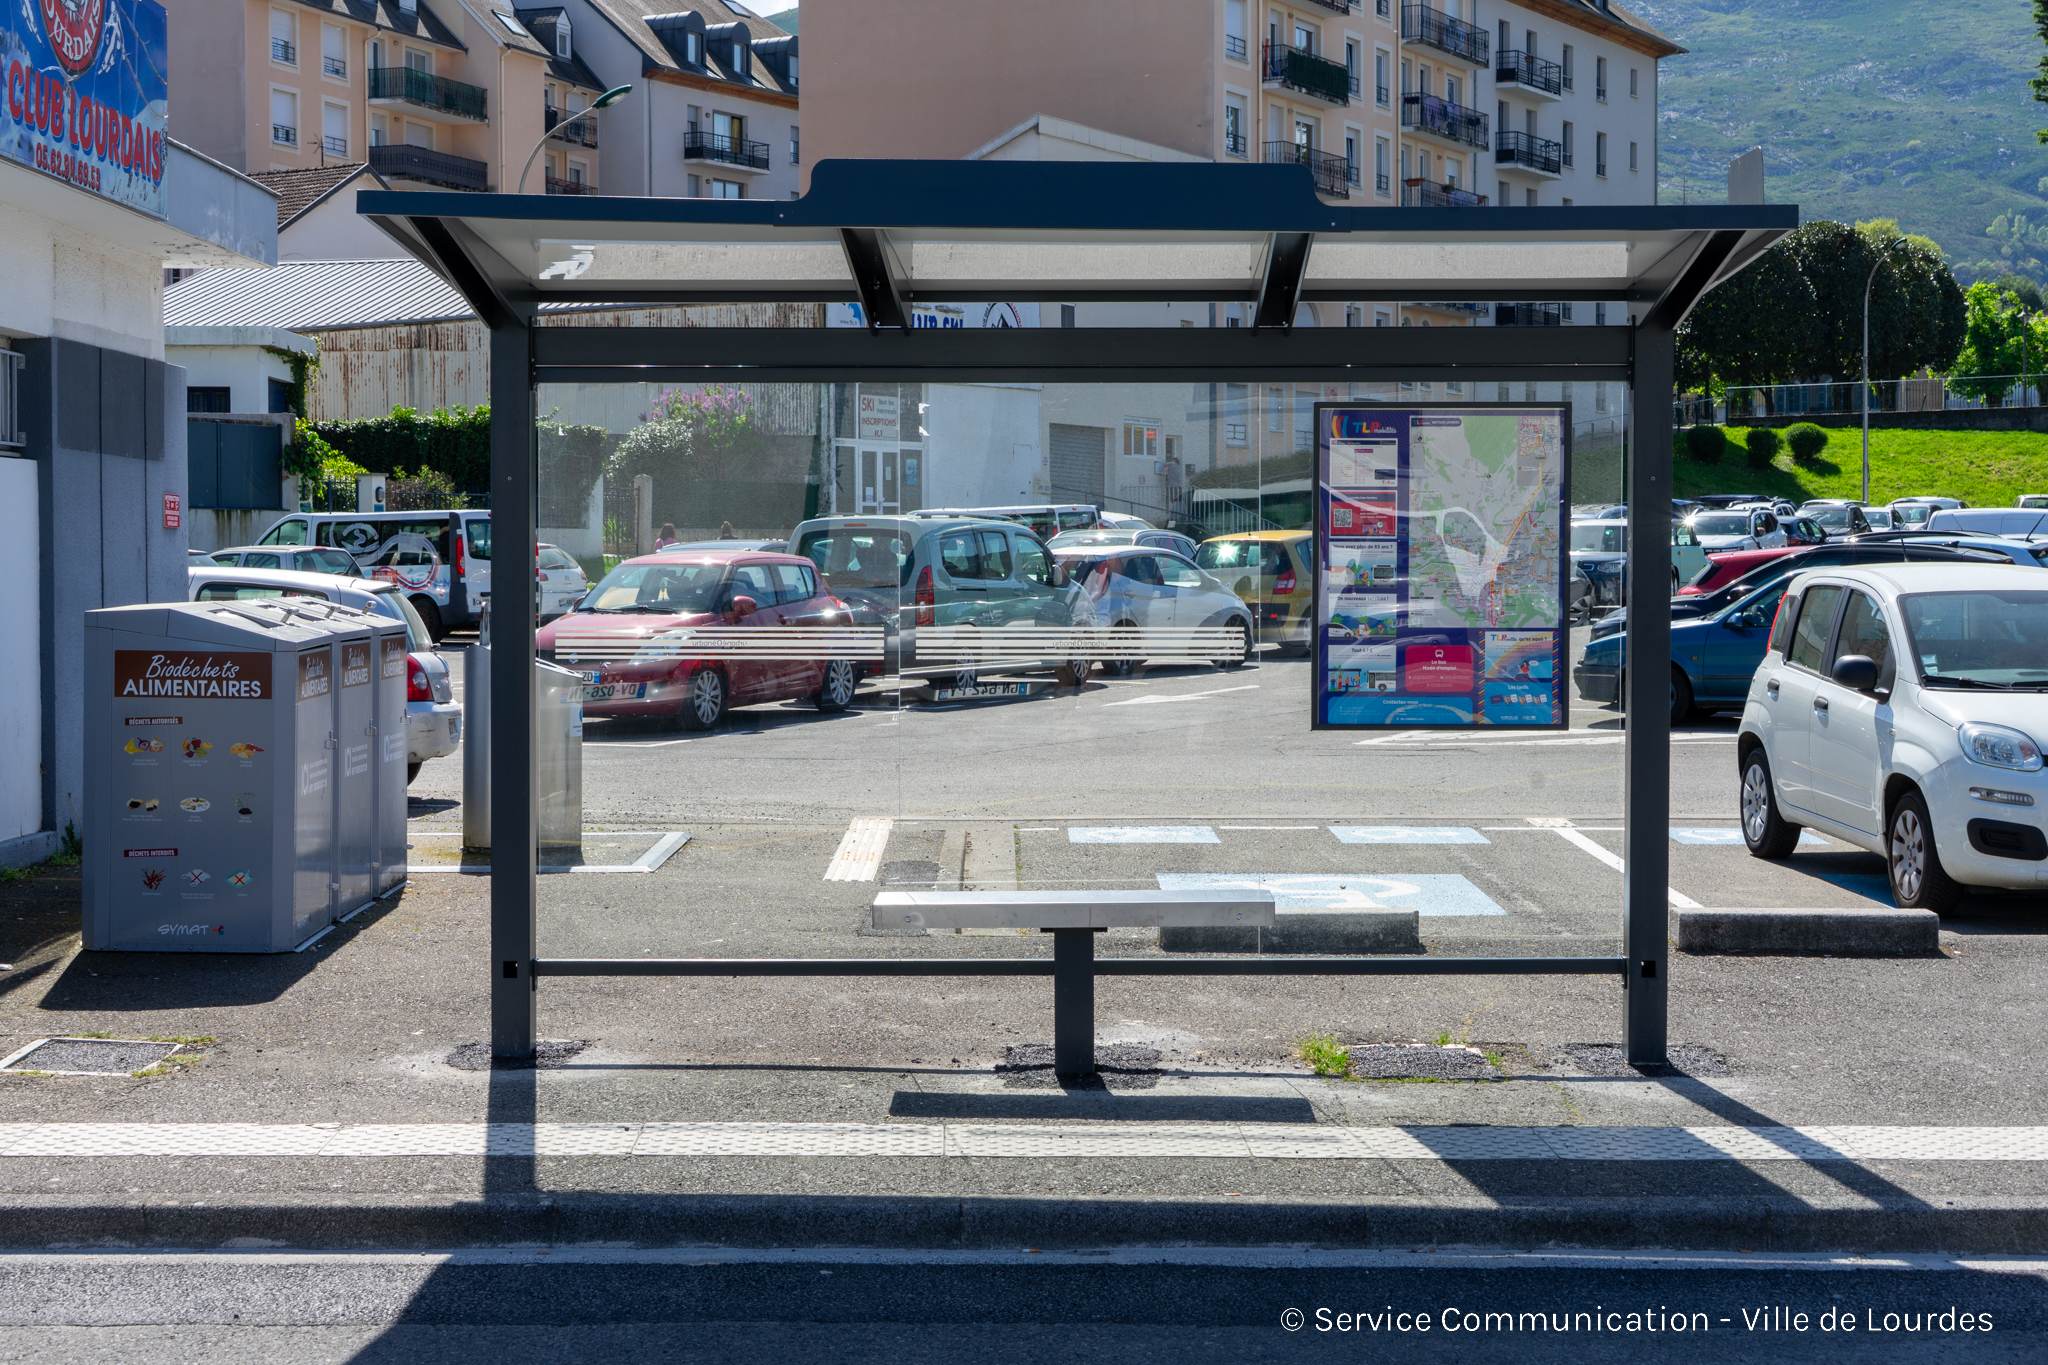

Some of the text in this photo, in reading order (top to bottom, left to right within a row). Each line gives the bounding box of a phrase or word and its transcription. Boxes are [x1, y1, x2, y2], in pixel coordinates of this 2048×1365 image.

[45, 0, 101, 61] OURDAIS
[8, 60, 162, 186] CLUB LOURDAIS
[35, 142, 101, 191] 05.62.94.69.53
[861, 397, 875, 412] SKI
[861, 416, 897, 427] INSCRIPTIONS
[1352, 421, 1381, 434] TLP
[874, 429, 883, 437] ICI
[145, 655, 240, 679] Biodéchets
[122, 679, 262, 697] ALIMENTAIRES
[128, 717, 179, 726] DÉCHETS AUTORISÉS
[128, 849, 175, 857] DÉCHETS INTERDITS
[157, 923, 210, 936] SYMAT
